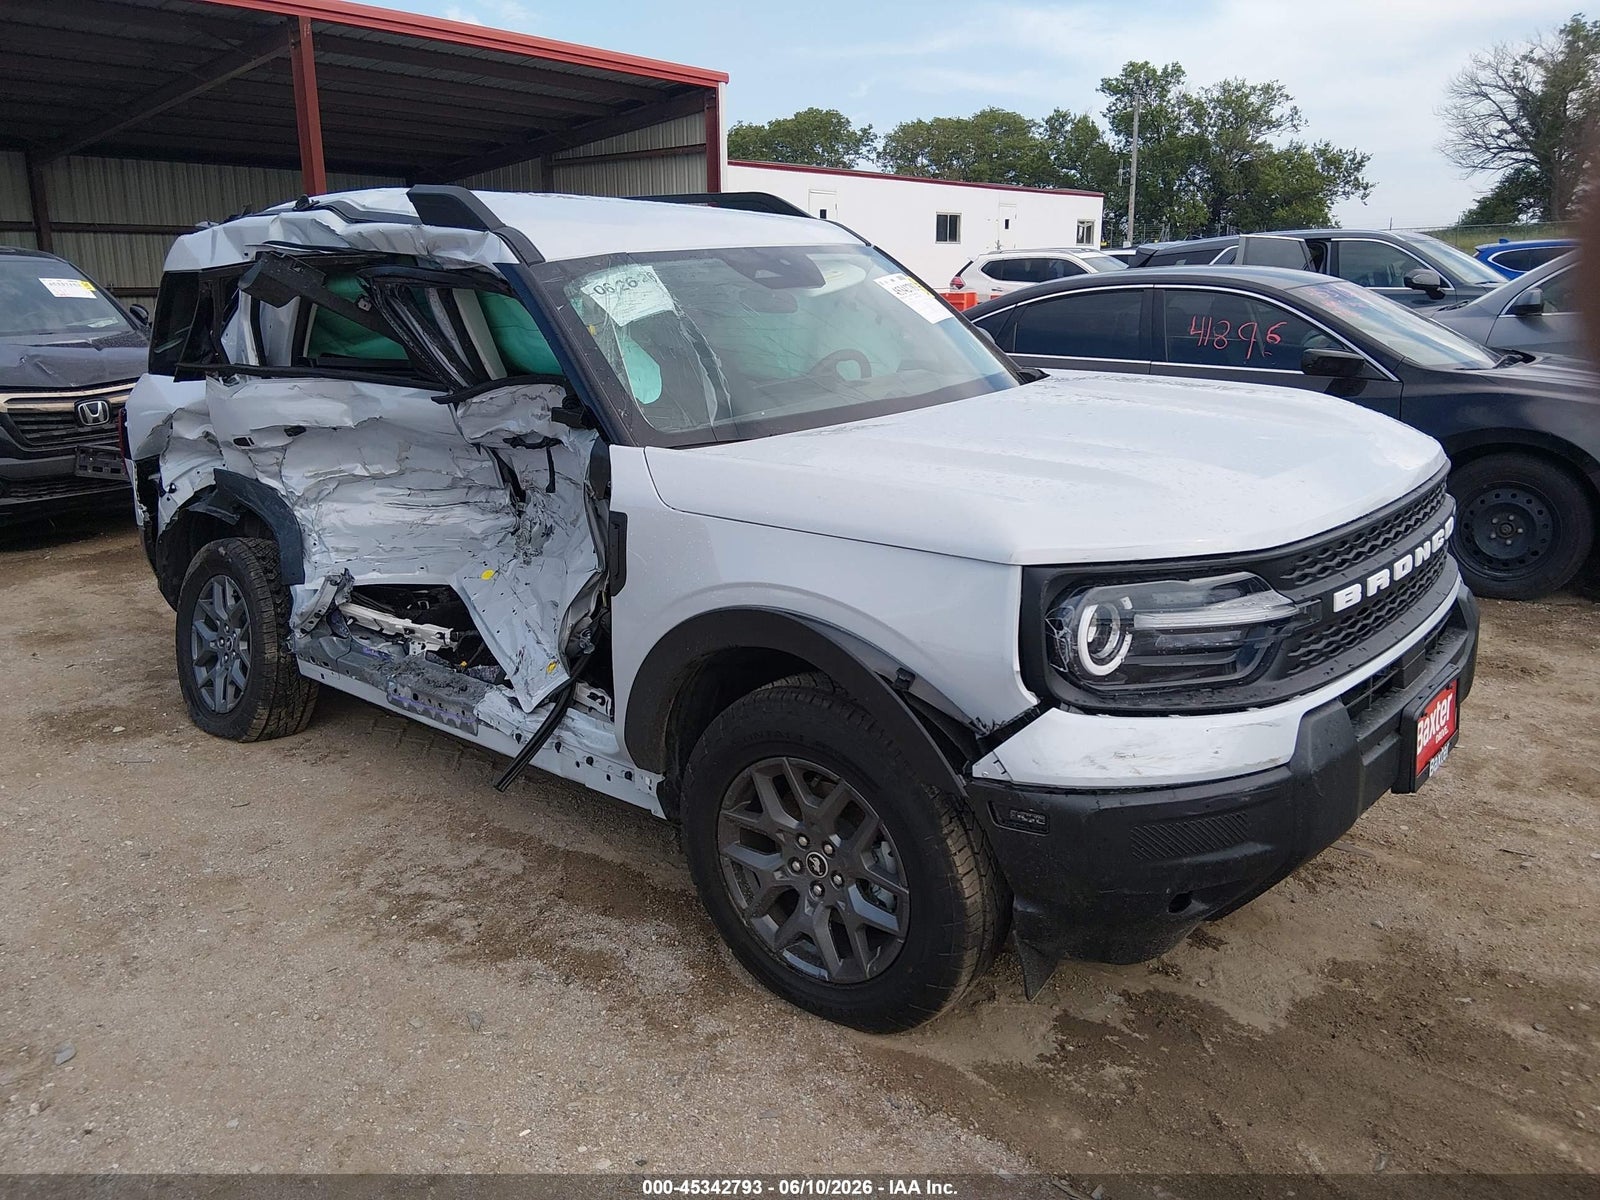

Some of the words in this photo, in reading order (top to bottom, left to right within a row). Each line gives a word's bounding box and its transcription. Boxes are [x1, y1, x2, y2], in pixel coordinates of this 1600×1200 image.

[1190, 315, 1288, 360] 41896
[1333, 516, 1455, 613] BRONCO
[1416, 692, 1453, 756] Baxter
